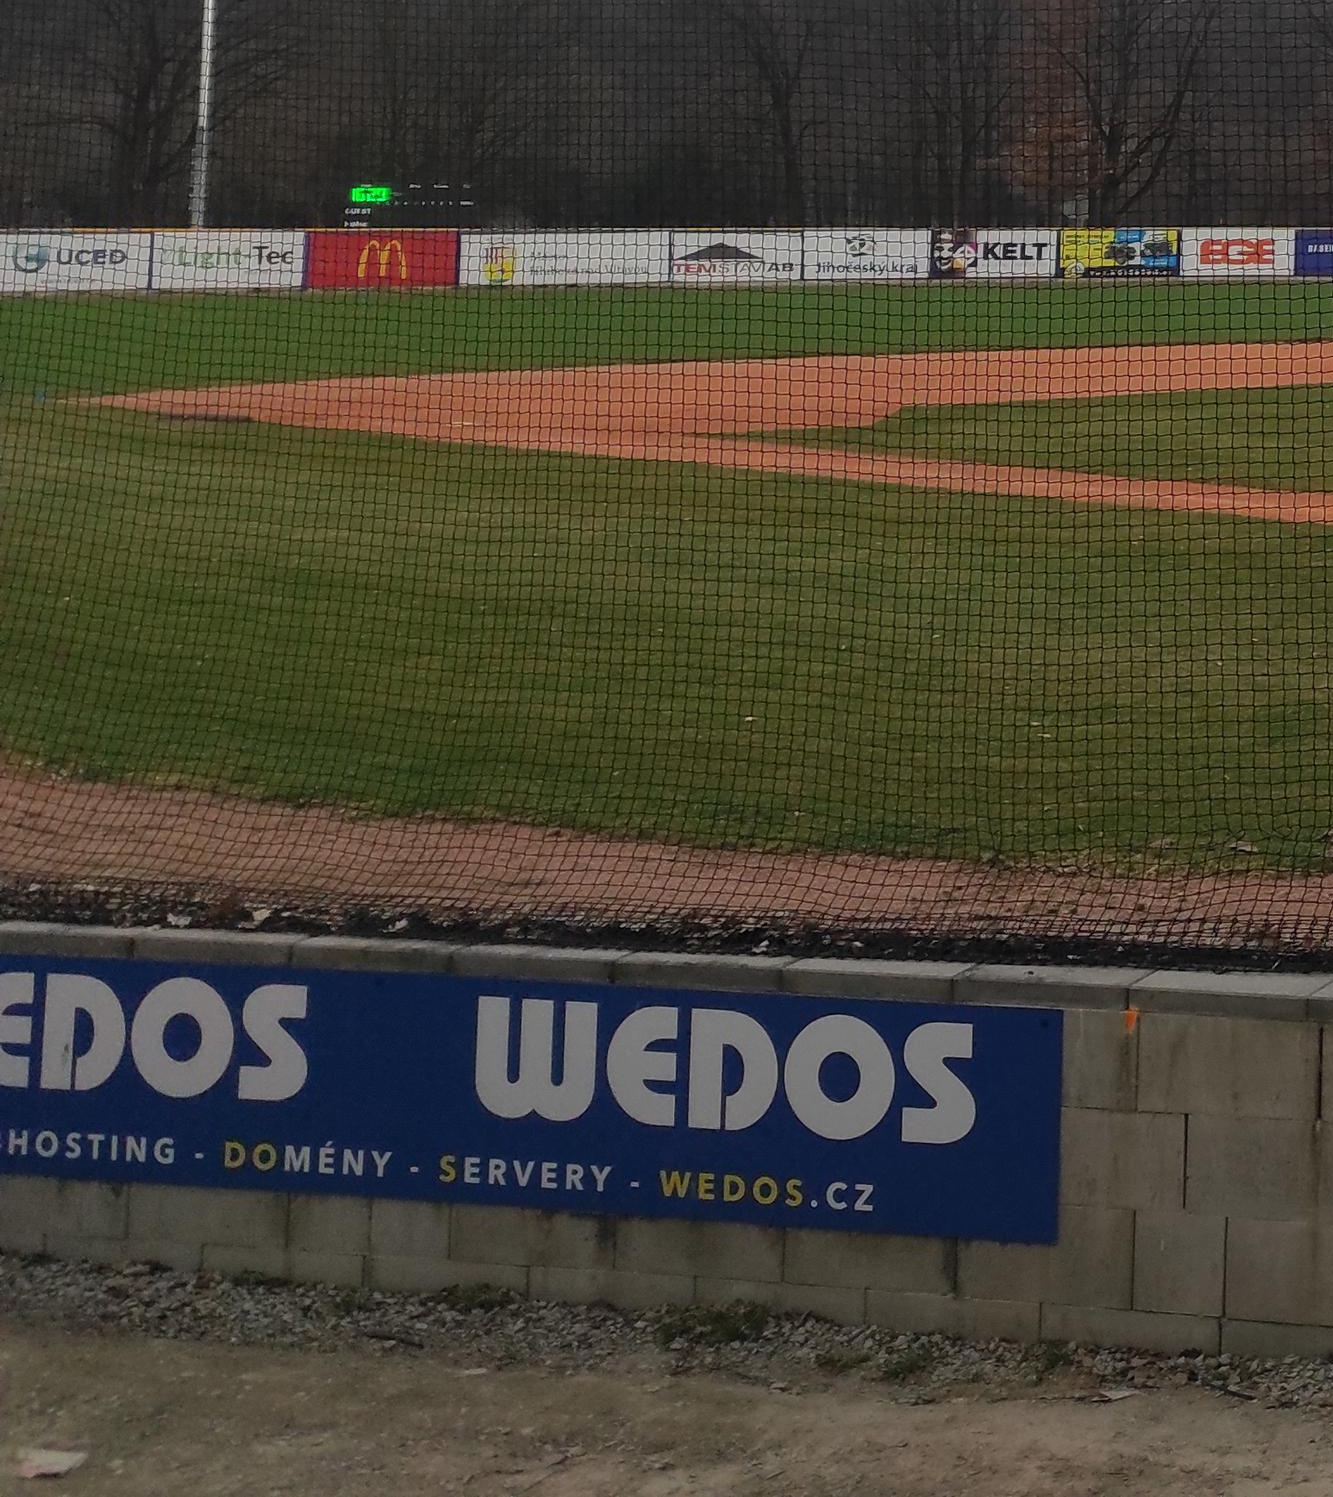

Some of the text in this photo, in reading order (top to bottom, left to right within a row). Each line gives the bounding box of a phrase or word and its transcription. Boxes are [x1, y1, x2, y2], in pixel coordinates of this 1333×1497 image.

[57, 248, 127, 265] UCED
[983, 241, 1048, 261] KELT
[475, 995, 976, 1145] WEDOS
[0, 1128, 176, 1166] HOSTING
[224, 1138, 393, 1179] DOMÉNY
[439, 1154, 614, 1193] SERVERY
[660, 1169, 875, 1212] WEDOS.CZ
